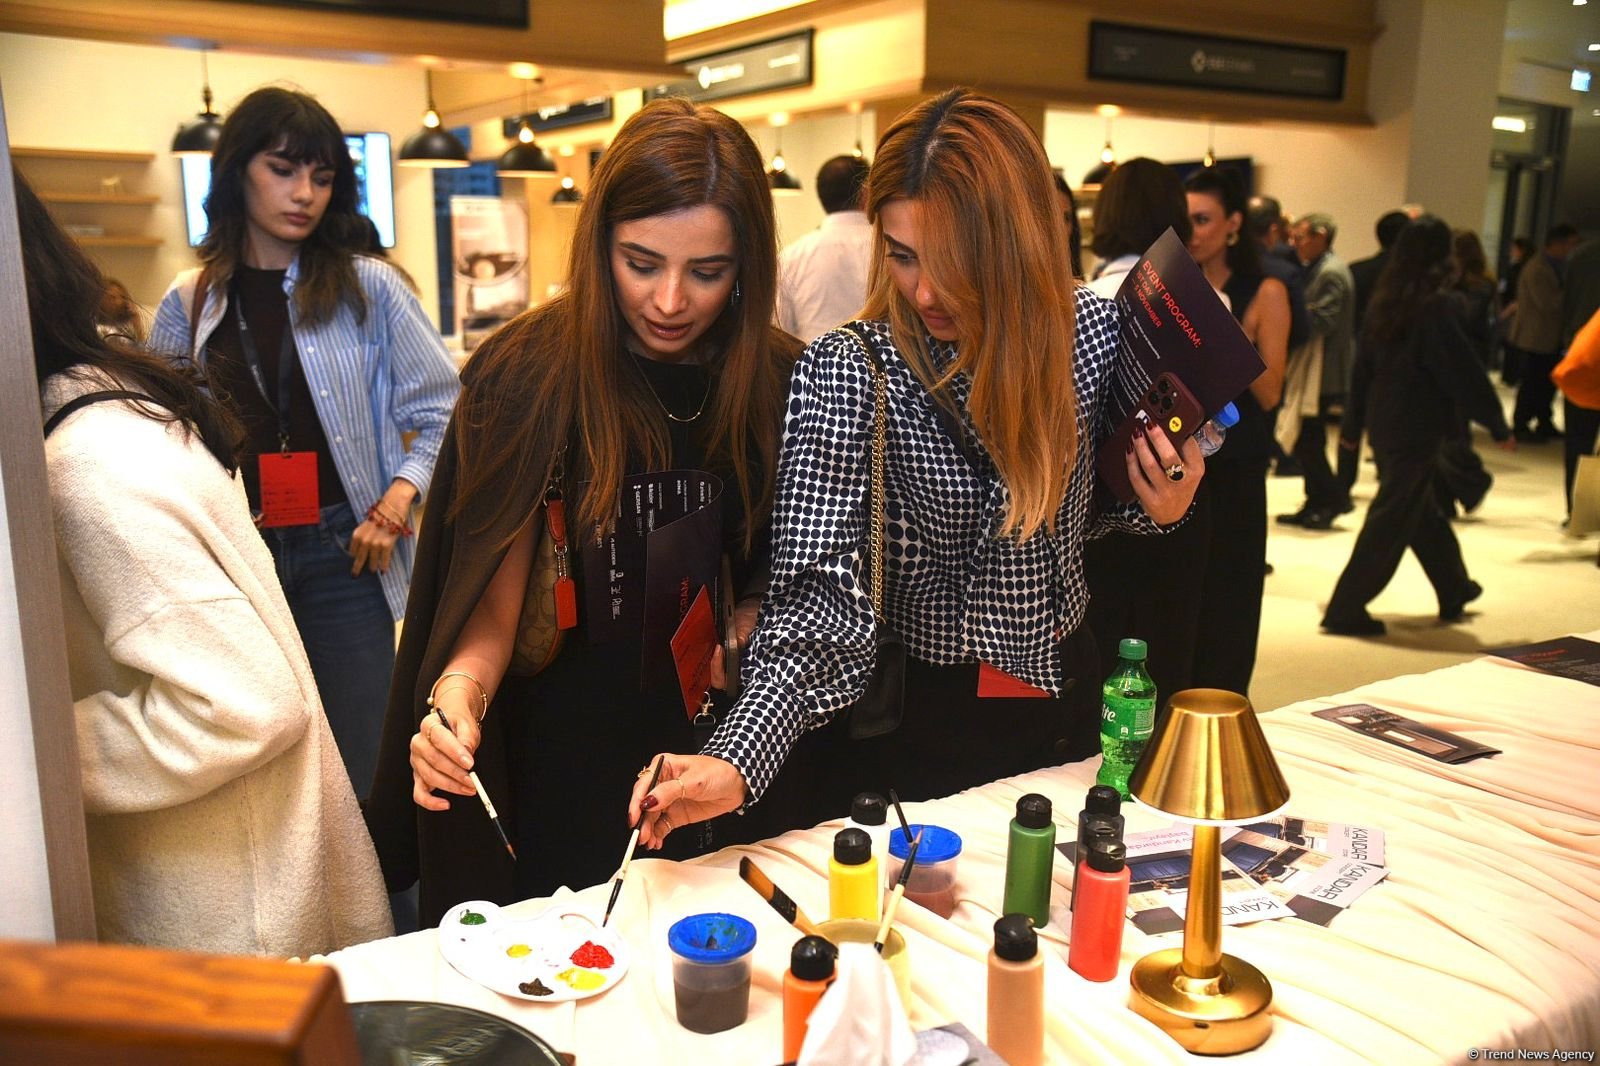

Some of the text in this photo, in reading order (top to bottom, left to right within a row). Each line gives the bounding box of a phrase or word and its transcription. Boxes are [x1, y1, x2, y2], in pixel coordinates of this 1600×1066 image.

[1141, 281, 1153, 296] DAY
[1142, 260, 1202, 348] EVENT PROGRAM:
[1138, 289, 1163, 328] NOVEMBER
[1351, 827, 1369, 860] KANDAR
[1316, 864, 1372, 900] KANDAR
[1219, 900, 1279, 916] KAND
